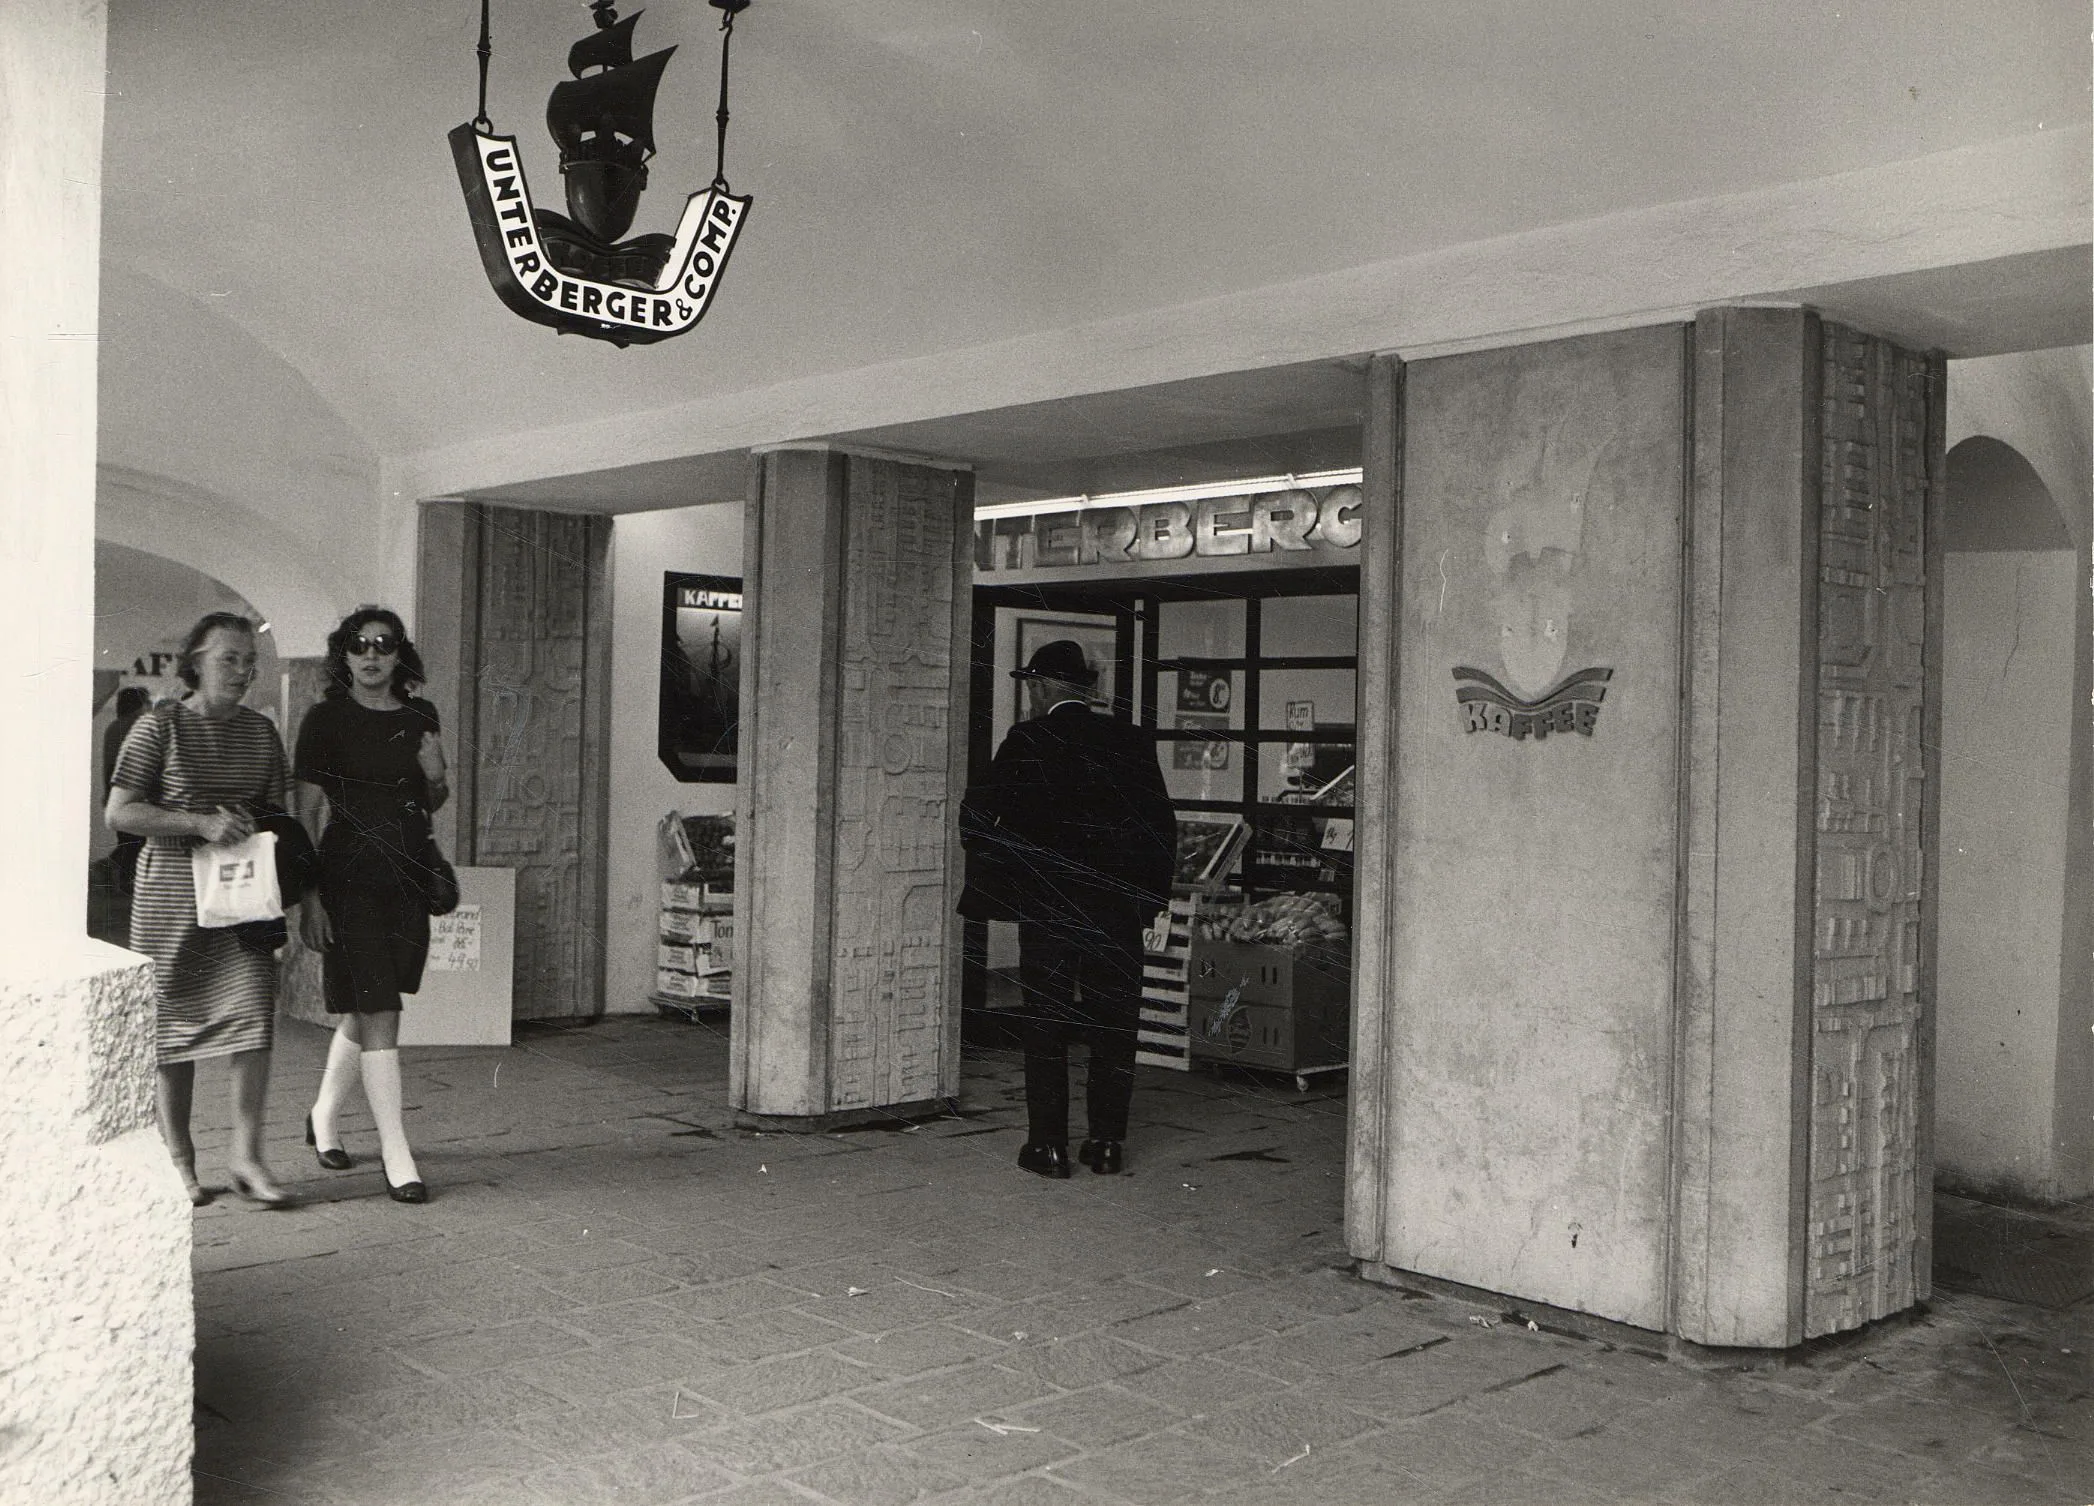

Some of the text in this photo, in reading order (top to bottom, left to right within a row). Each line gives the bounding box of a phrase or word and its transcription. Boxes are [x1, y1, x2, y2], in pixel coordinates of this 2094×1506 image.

[486, 148, 738, 327] UNTERBERGER & COMP.
[1458, 701, 1600, 740] KAFFEE
